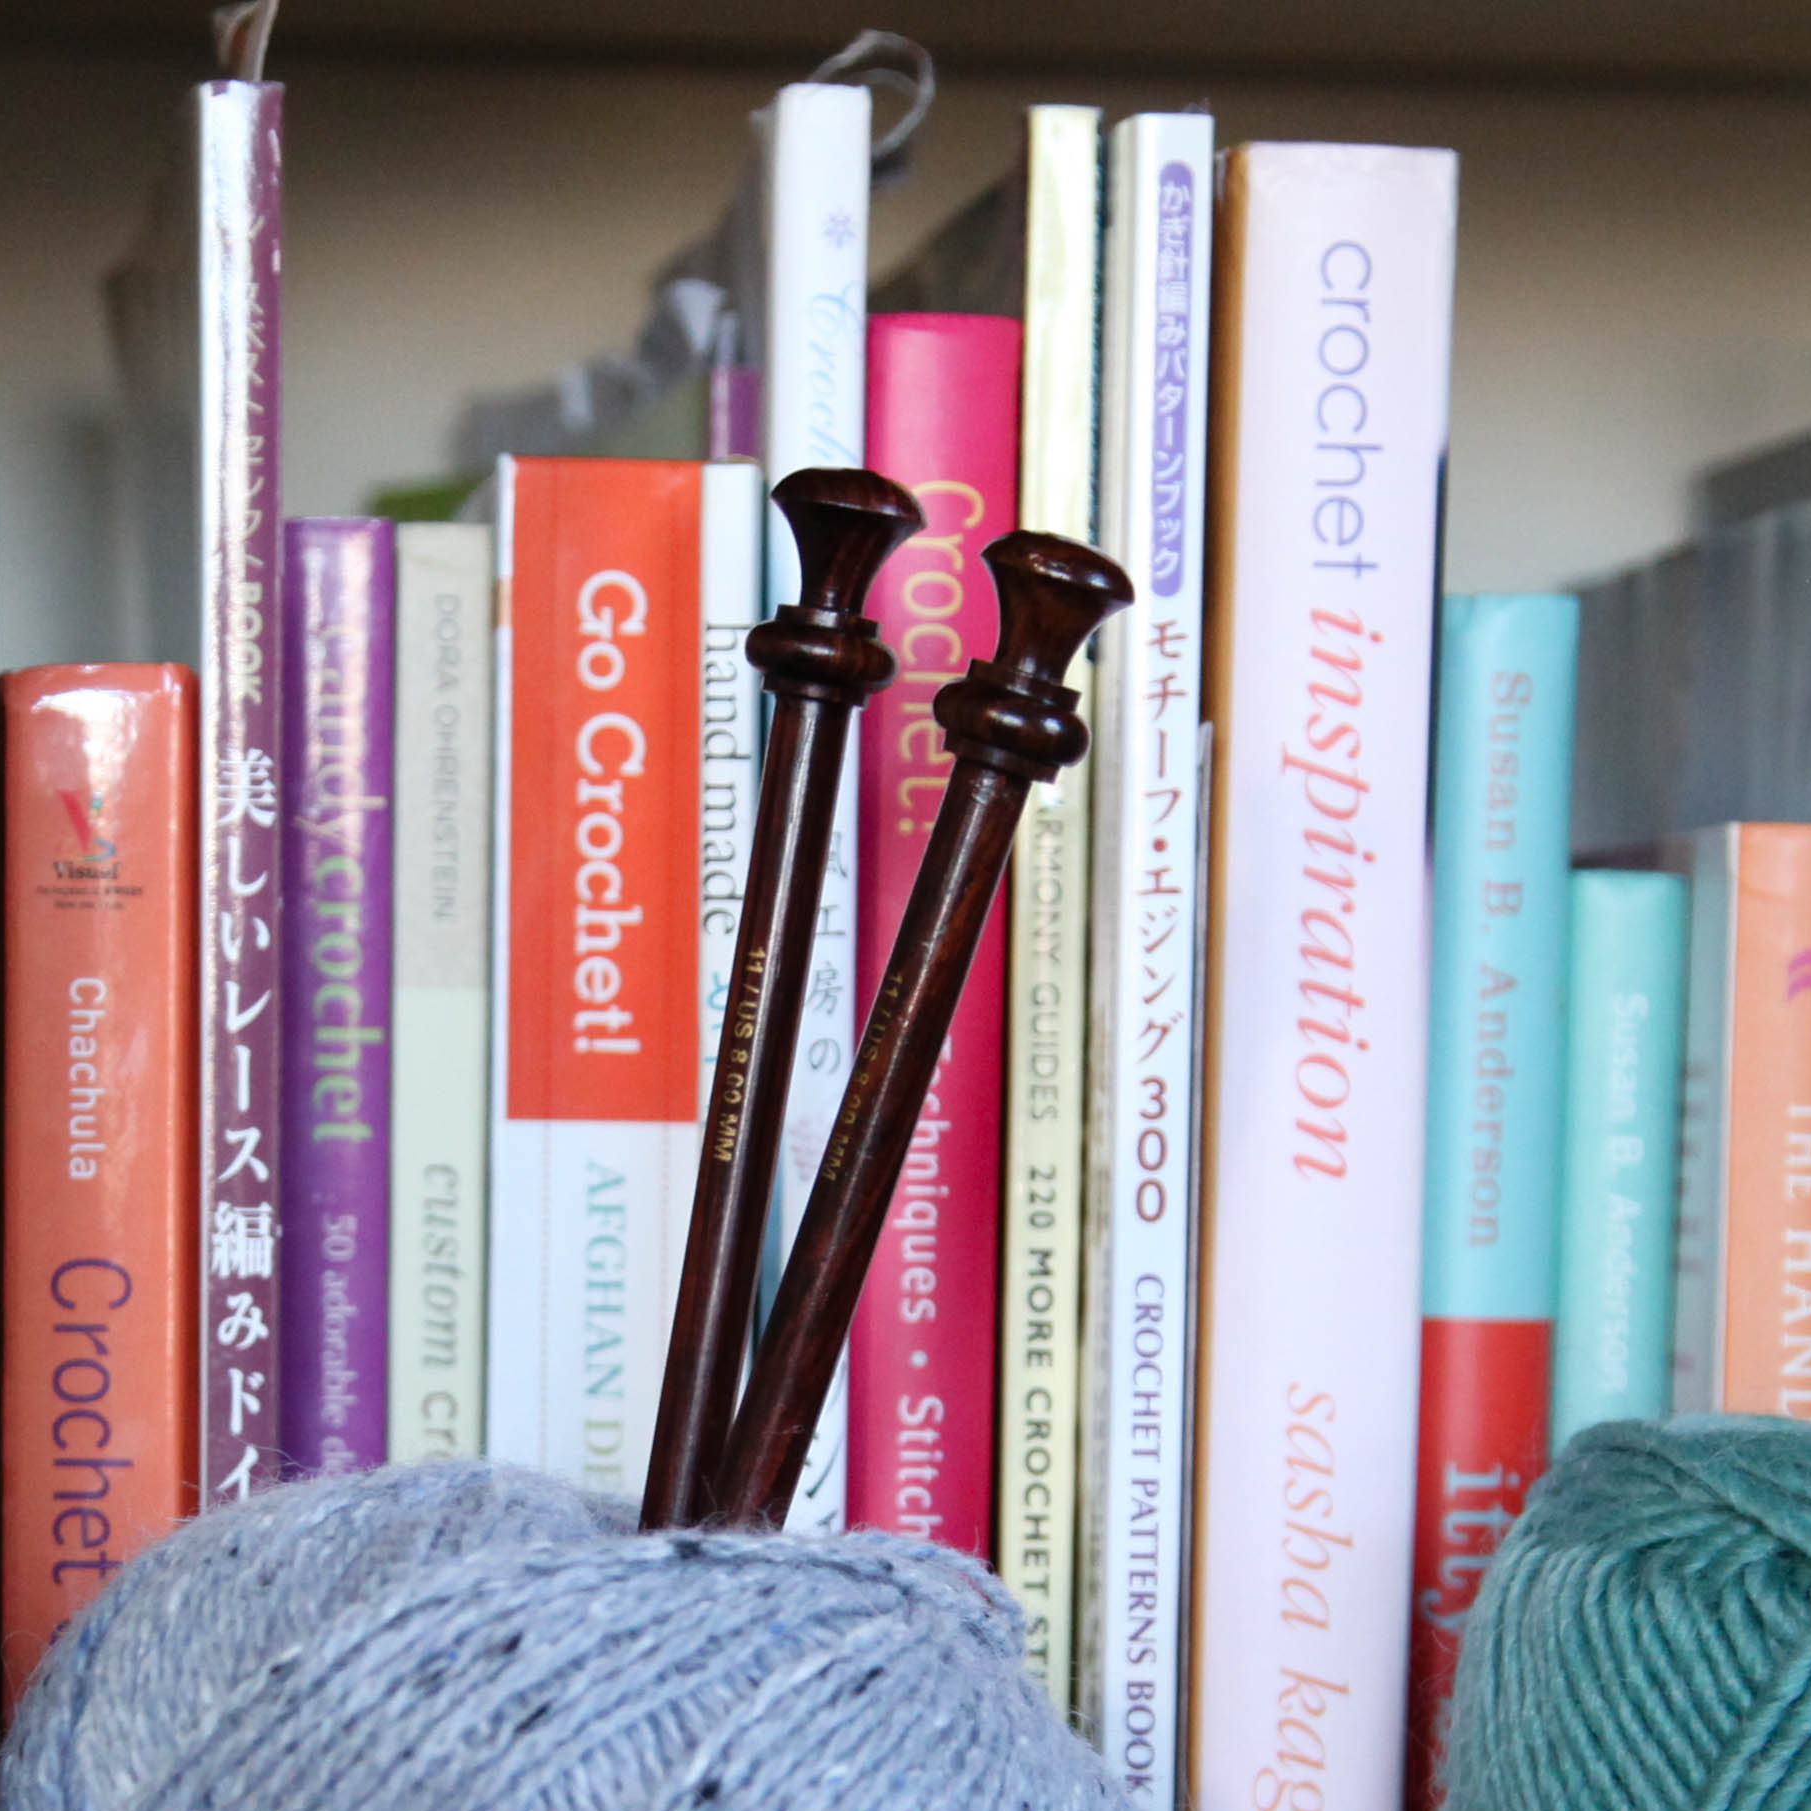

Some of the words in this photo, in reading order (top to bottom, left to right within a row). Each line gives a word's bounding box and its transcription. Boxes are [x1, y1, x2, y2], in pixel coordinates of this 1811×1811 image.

[1312, 239, 1385, 581] crochet
[435, 592, 463, 694] DORA
[575, 569, 648, 691] Go
[428, 701, 462, 925] OHRENSTEIN
[1485, 670, 1535, 853] Susan
[573, 712, 647, 1056] Crochet!
[1281, 606, 1385, 1180] inspiration
[68, 976, 108, 1181] Chachula
[312, 854, 386, 1144] crochet
[1029, 982, 1062, 1124] GUIDES
[713, 1112, 740, 1165] MM
[892, 1036, 953, 1326] chniques
[1027, 1163, 1059, 1230] 220
[1469, 964, 1520, 1249] Anderson
[321, 1213, 359, 1262] 50
[420, 1161, 470, 1369] custom
[584, 1161, 627, 1401] AFGHAN
[1025, 1248, 1057, 1370] MORE
[50, 1258, 135, 1586] Crochet
[320, 1269, 360, 1429] adorable
[1131, 1272, 1166, 1465] CROCHET
[1022, 1386, 1055, 1596] CROCHET
[1126, 1477, 1163, 1667] PATTERNS
[1279, 1380, 1356, 1633] sasha
[1122, 1678, 1157, 1796] BOOK
